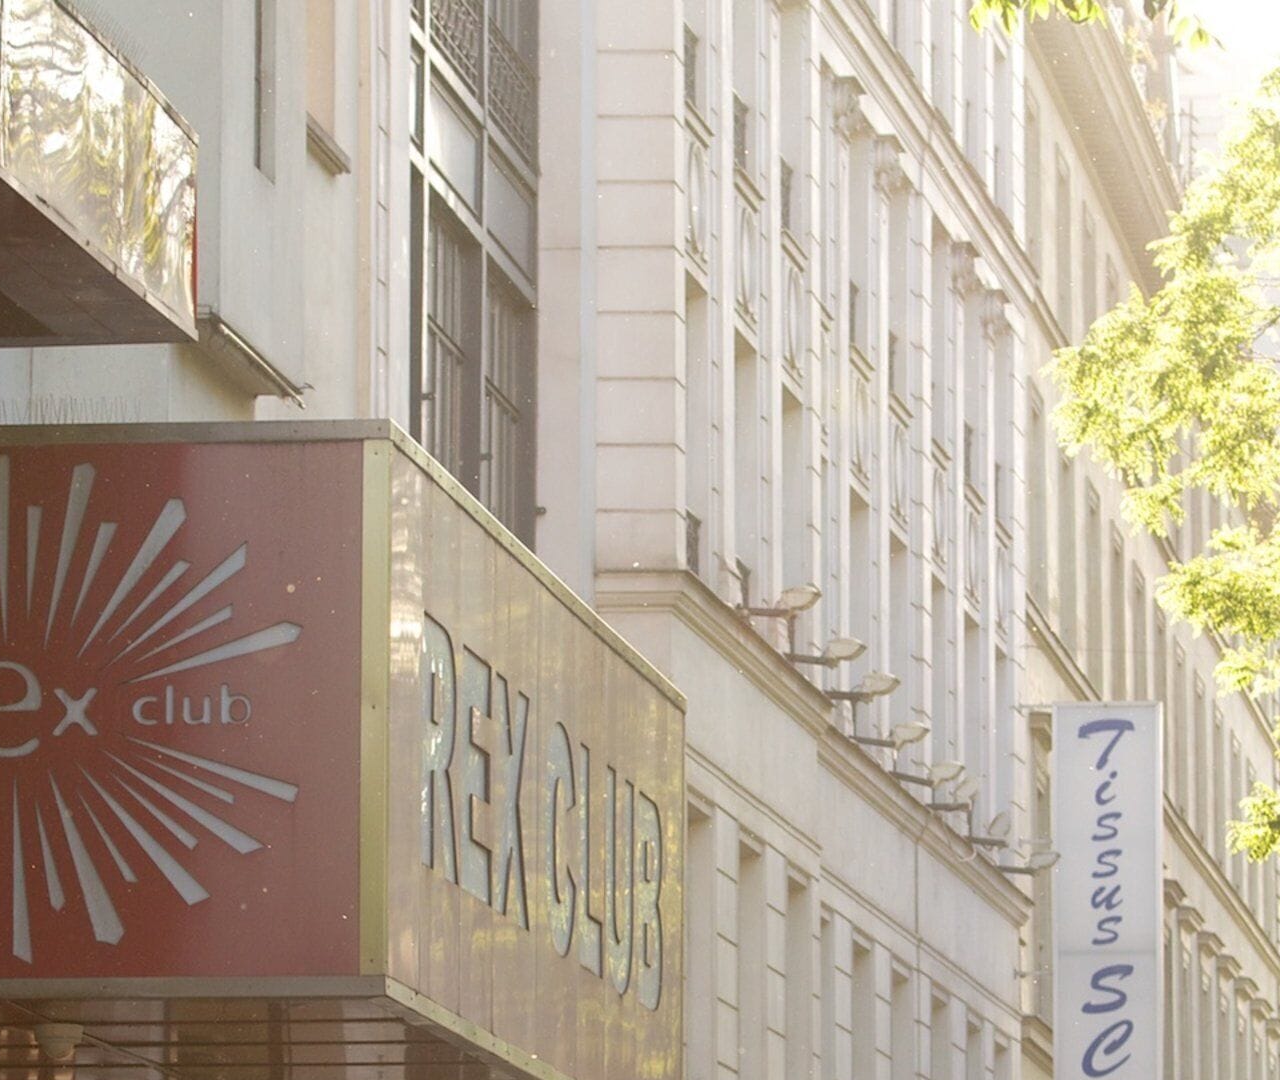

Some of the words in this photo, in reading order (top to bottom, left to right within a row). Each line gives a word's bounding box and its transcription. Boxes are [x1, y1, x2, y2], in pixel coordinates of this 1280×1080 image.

[131, 682, 253, 728] club
[420, 610, 530, 932] REX
[547, 719, 663, 1014] CLUB
[1077, 718, 1135, 946] Tissus
